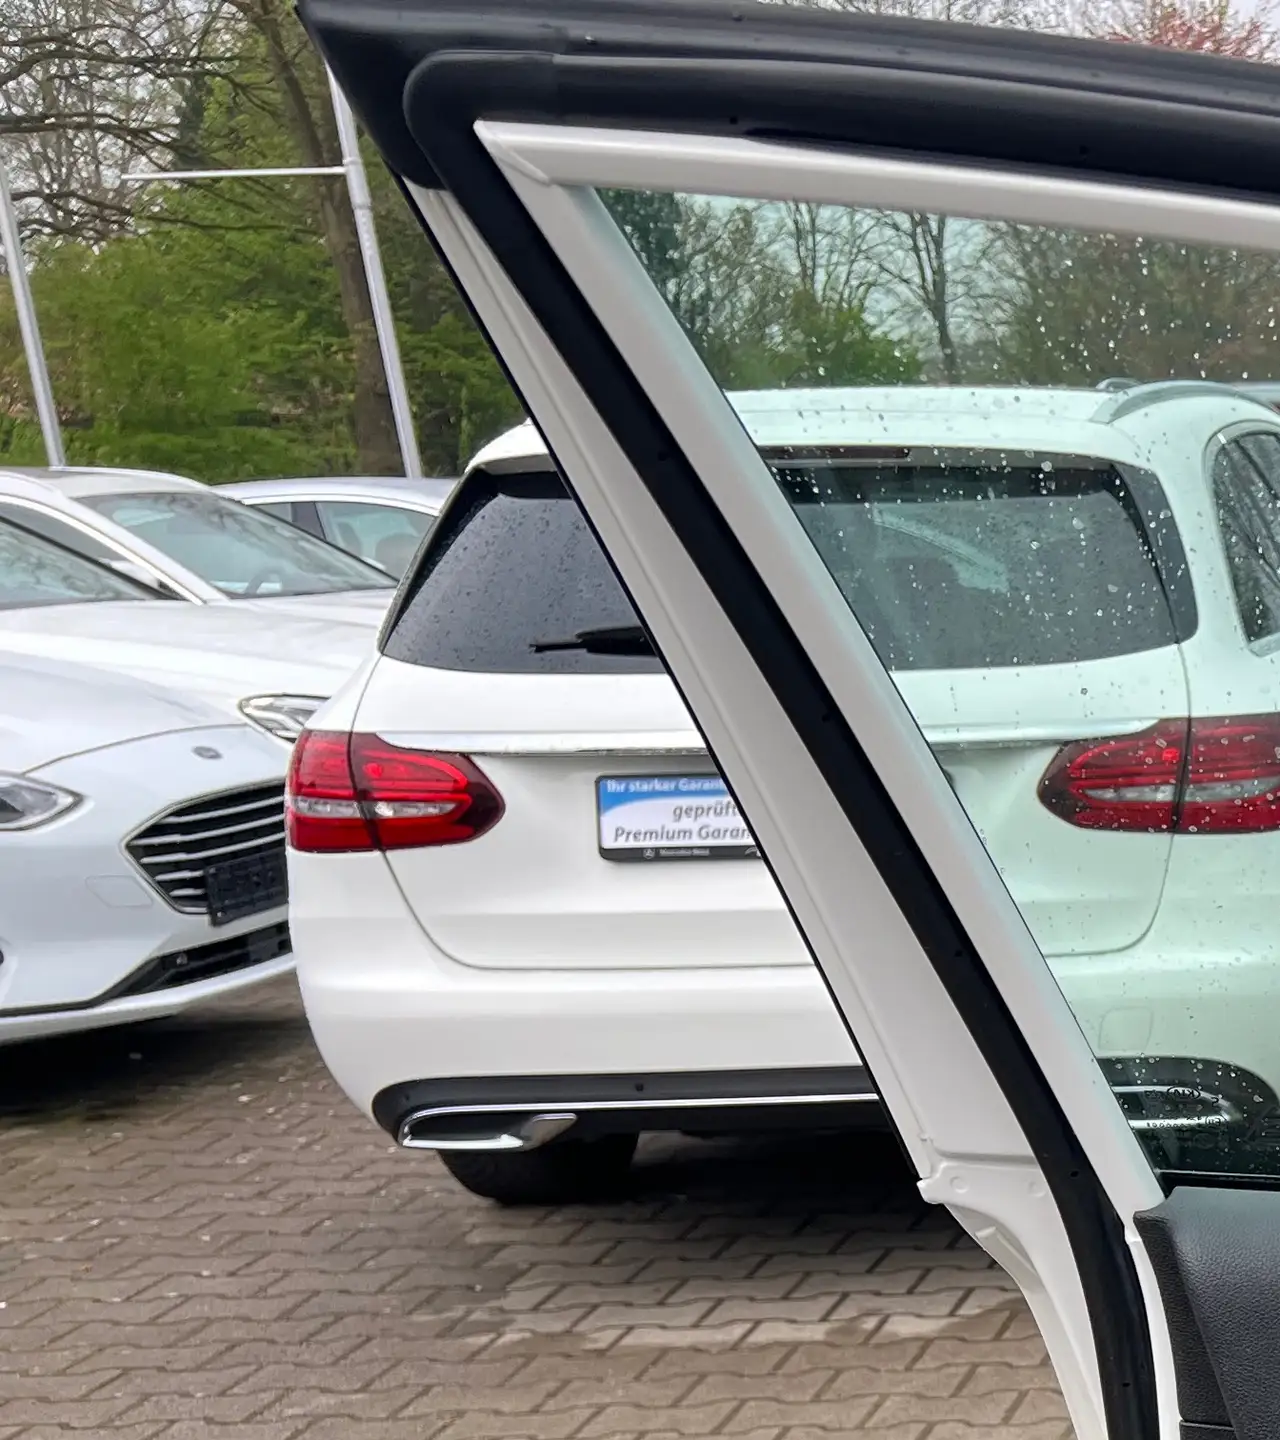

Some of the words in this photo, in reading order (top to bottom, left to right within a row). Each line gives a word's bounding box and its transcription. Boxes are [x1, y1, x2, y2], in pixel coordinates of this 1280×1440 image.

[606, 779, 626, 793] Ihr
[629, 778, 675, 793] starker
[614, 825, 693, 843] Premium
